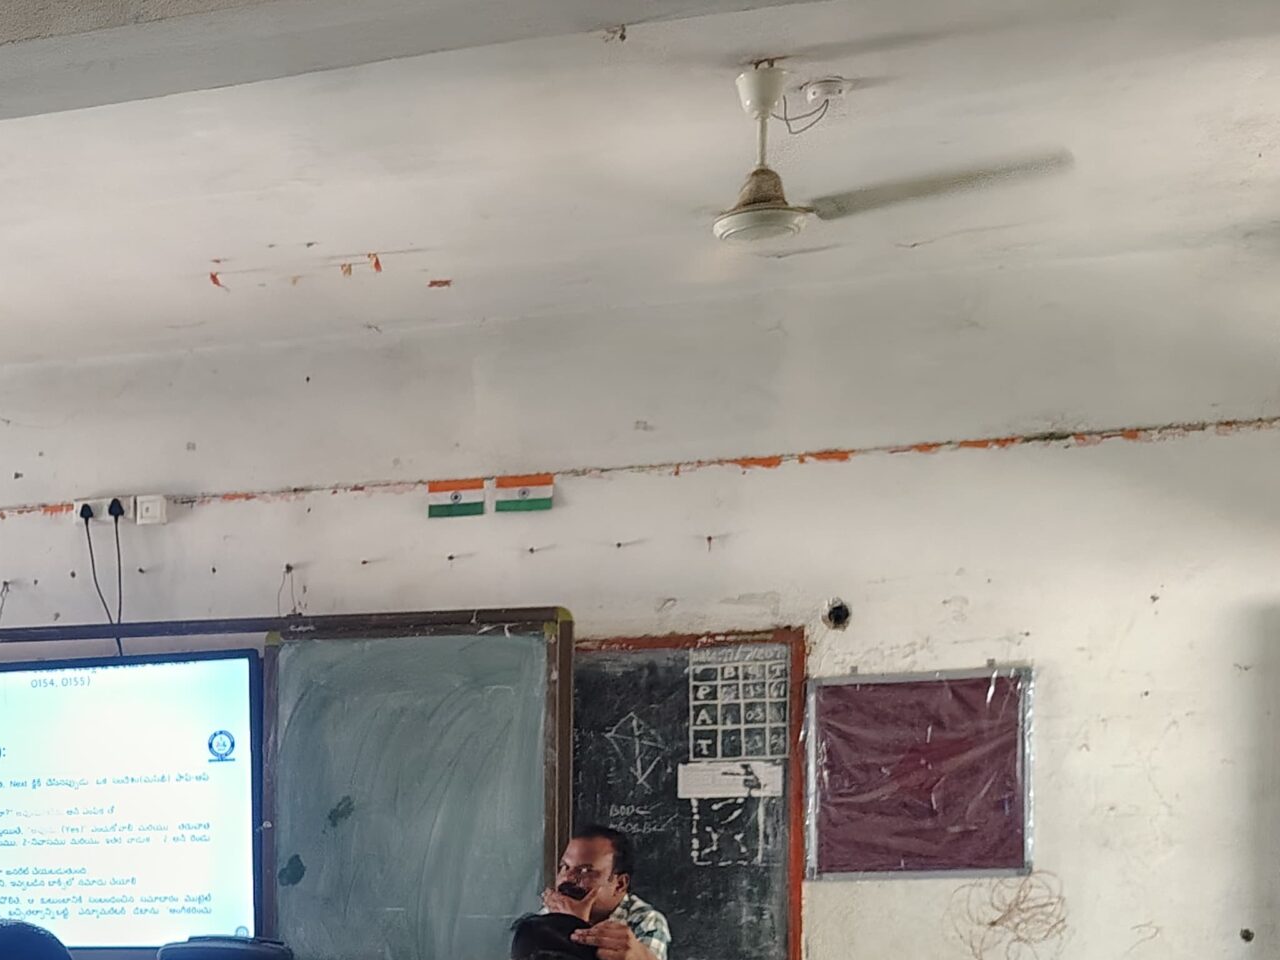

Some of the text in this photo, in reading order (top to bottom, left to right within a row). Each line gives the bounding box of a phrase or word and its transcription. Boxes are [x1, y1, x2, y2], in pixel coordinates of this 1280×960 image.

[61, 676, 91, 688] 0155)
[696, 685, 711, 699] P
[695, 709, 713, 725] A
[696, 739, 713, 755] T
[10, 780, 27, 788] Next
